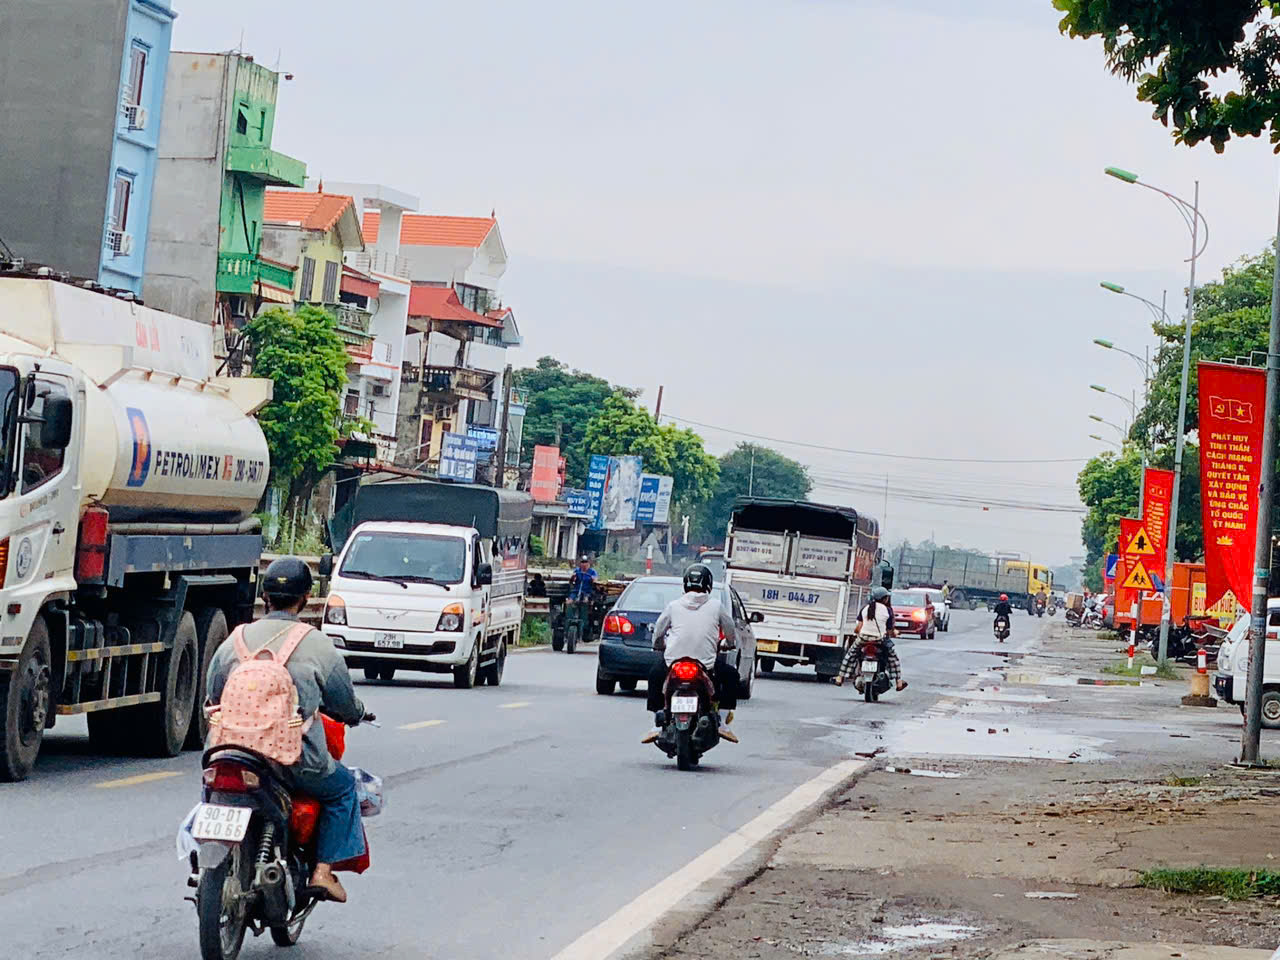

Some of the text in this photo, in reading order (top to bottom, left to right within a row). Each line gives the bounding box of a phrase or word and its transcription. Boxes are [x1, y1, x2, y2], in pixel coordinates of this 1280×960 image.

[1233, 433, 1248, 442] HUY
[1206, 451, 1252, 463] CÁCH MẠNG
[154, 450, 220, 480] PETROLIMEX
[1211, 461, 1236, 470] THÁNG
[1207, 471, 1250, 482] QUYẾT TÂM
[1208, 480, 1247, 492] XÂY DỰNG
[1208, 490, 1247, 502] VÀ BẢO VỆ
[1228, 501, 1249, 510] CHẮC
[1222, 510, 1243, 520] QUỐC
[762, 589, 779, 600] 18H
[204, 807, 241, 822] 90-D1
